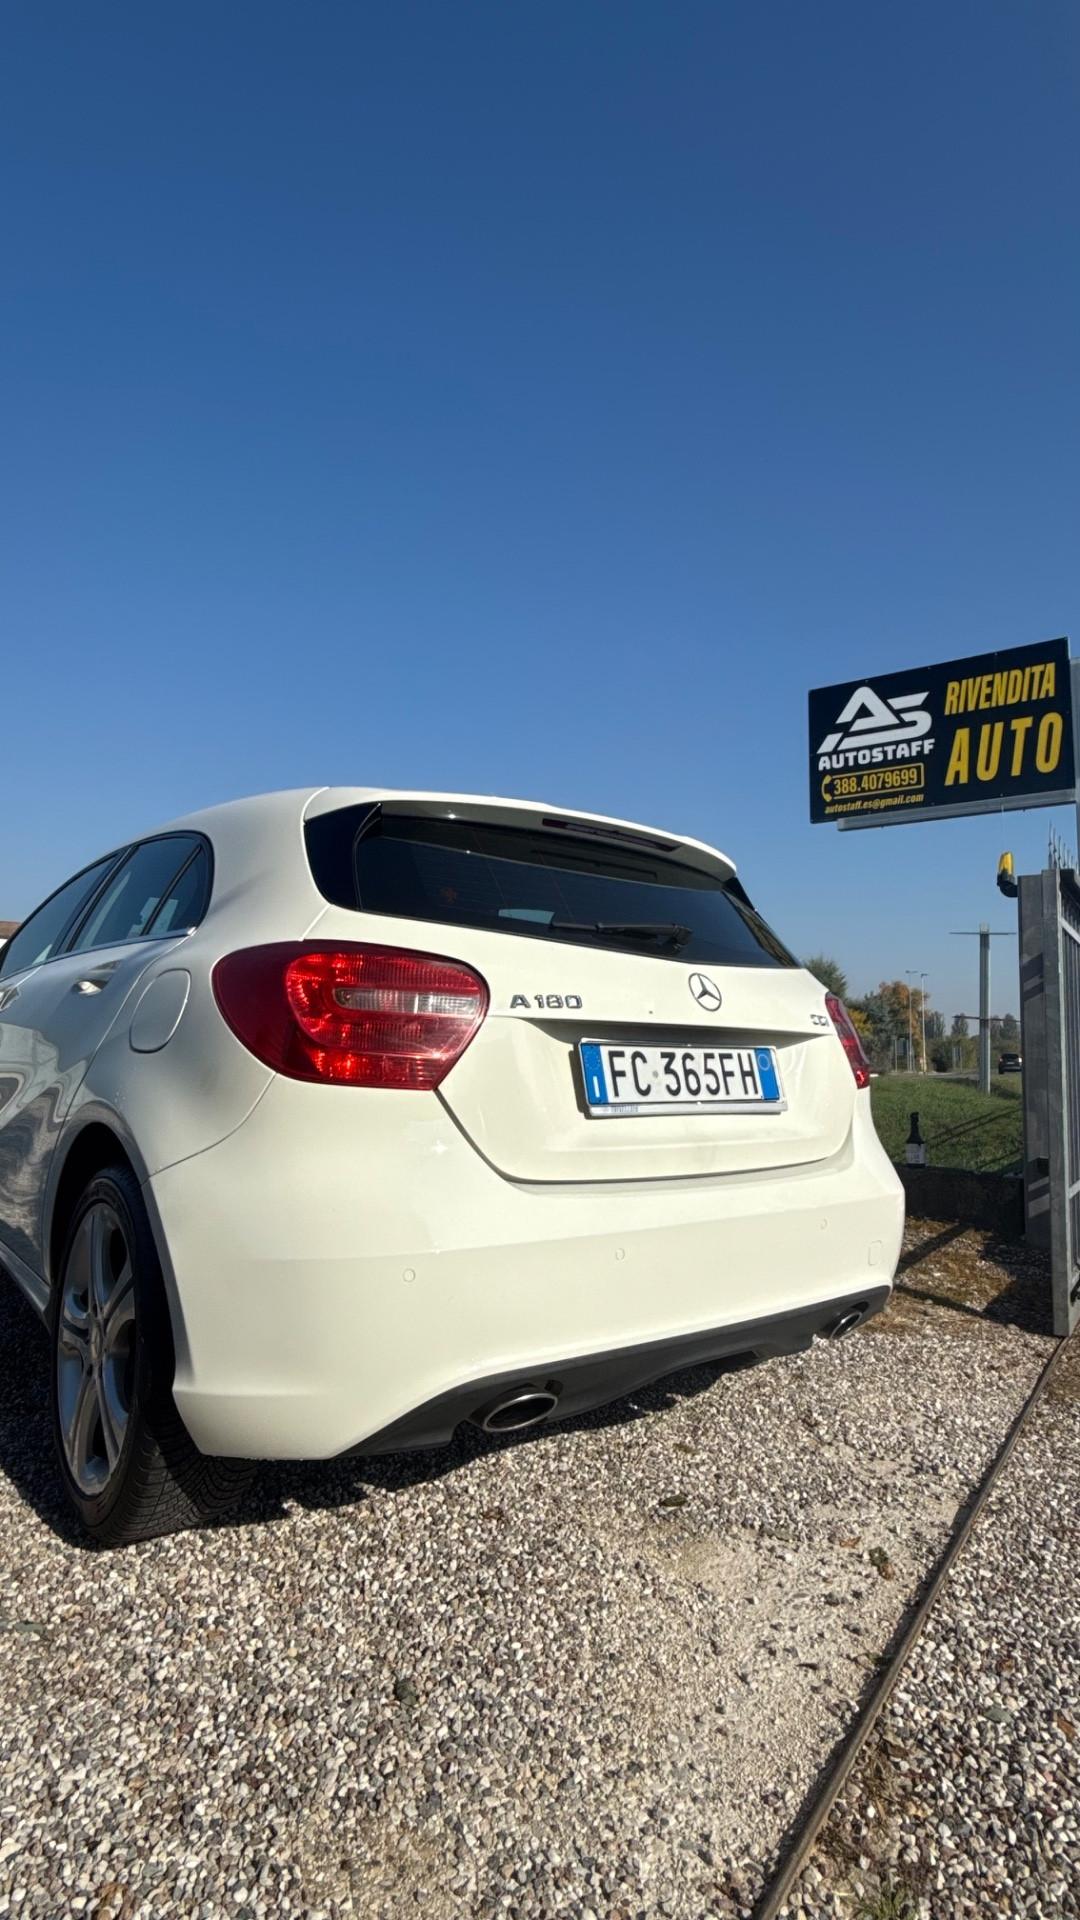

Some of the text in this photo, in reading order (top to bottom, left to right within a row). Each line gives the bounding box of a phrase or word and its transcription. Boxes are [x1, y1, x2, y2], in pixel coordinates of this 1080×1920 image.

[944, 662, 1056, 716] RIVENDITA
[818, 738, 936, 771] AUTOSTAFF
[944, 712, 1063, 786] AUTO
[833, 767, 918, 795] 388.4079699
[824, 794, 925, 814] autostaff.es@gmail.com
[608, 1050, 759, 1098] FC 365FH
